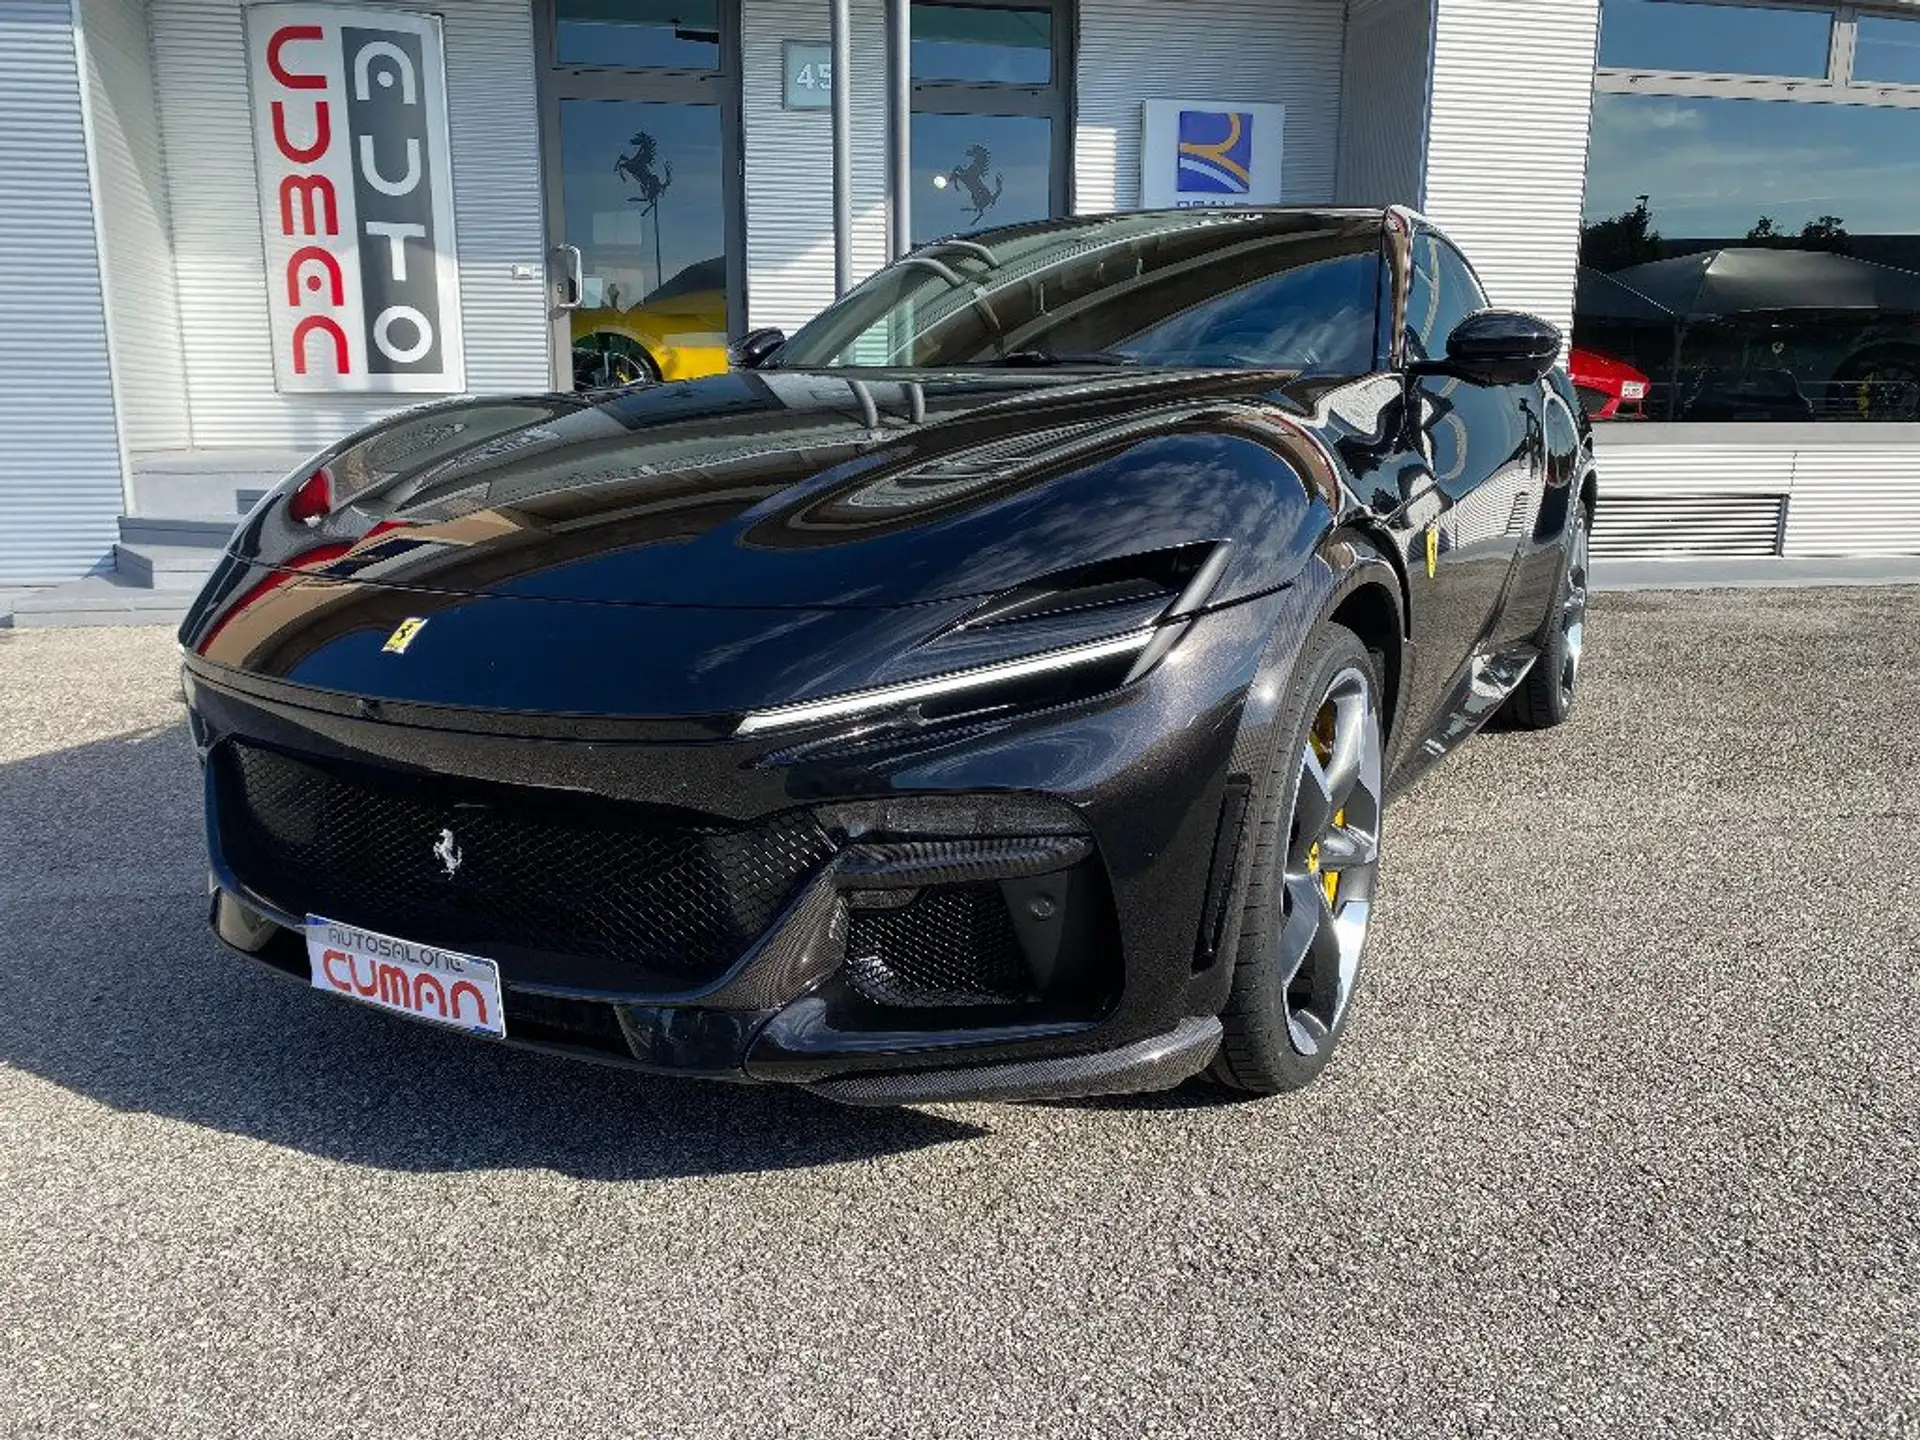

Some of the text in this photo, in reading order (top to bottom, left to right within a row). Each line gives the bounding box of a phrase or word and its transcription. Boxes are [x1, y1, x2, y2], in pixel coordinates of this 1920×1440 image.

[266, 26, 350, 374] CUMAN
[354, 41, 433, 363] AUTO
[323, 949, 488, 1024] CUMAN
